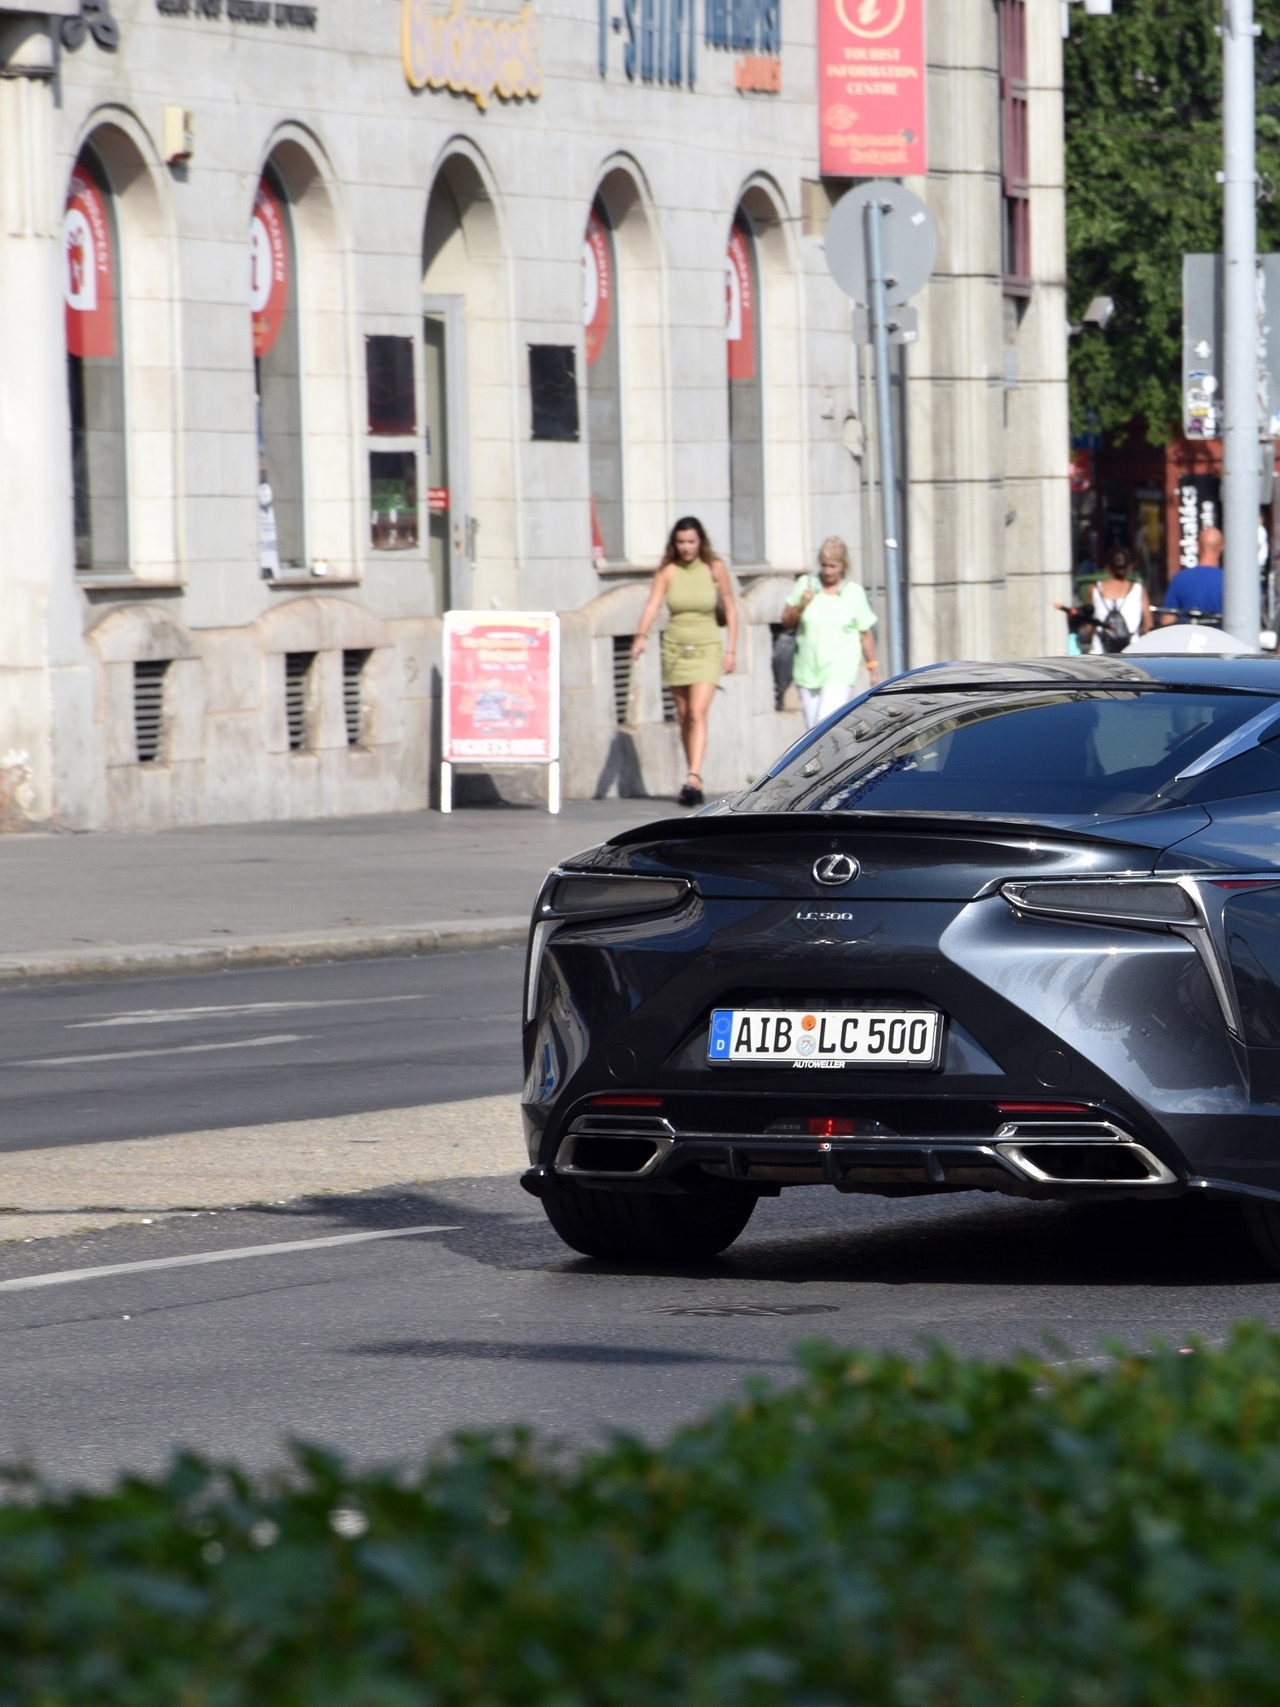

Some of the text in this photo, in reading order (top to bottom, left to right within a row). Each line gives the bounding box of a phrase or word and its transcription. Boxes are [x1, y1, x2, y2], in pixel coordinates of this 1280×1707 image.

[844, 47, 901, 61] TOURIST
[826, 64, 918, 79] INFORMATION
[846, 82, 898, 95] CENTRE
[452, 738, 546, 755] TICKETS HERE
[796, 911, 853, 921] LC 500
[734, 1017, 928, 1055] AIB LC 500
[717, 1040, 725, 1050] D
[793, 1060, 846, 1069] AUTOWELLER
